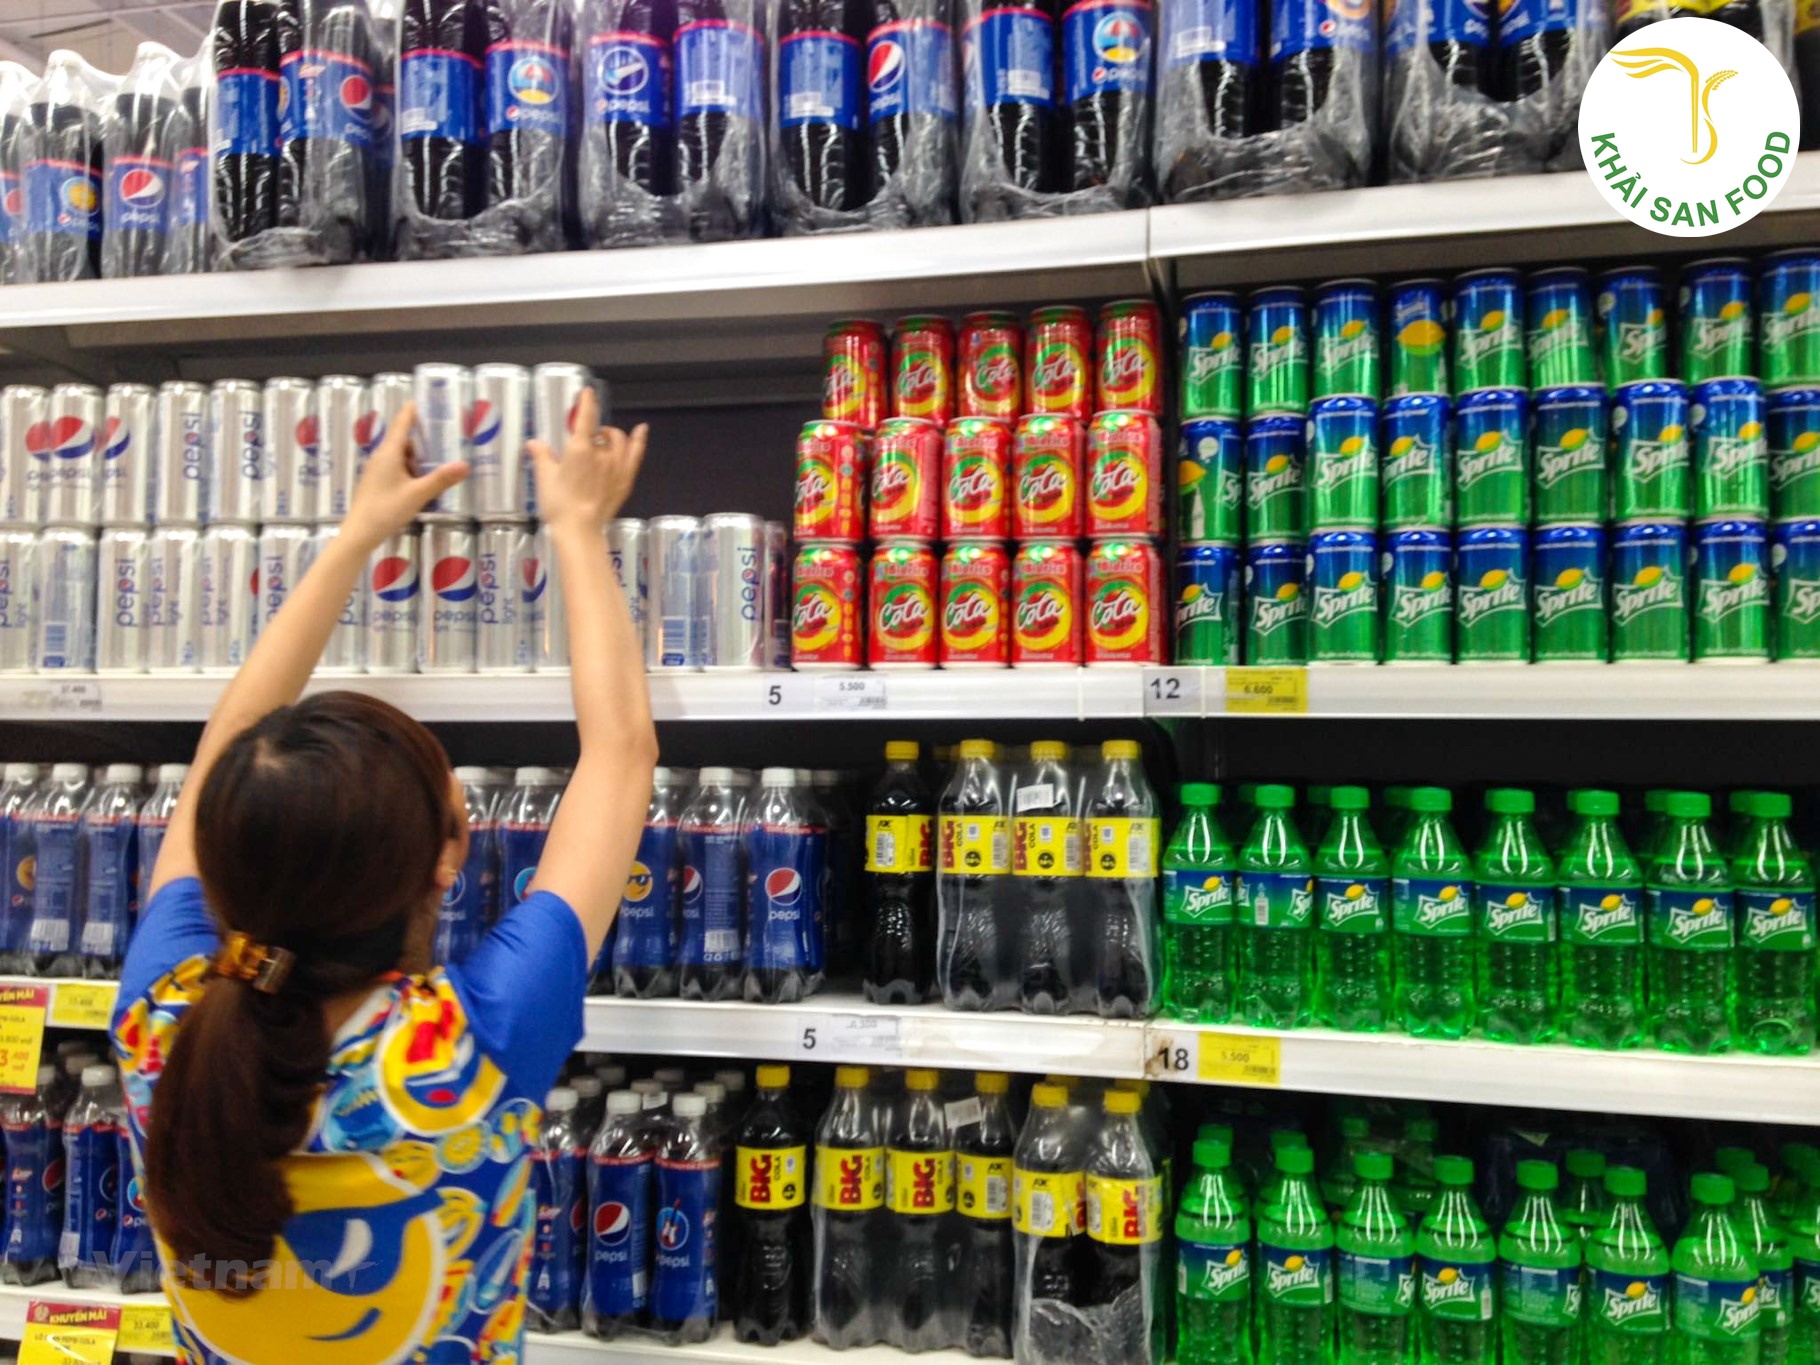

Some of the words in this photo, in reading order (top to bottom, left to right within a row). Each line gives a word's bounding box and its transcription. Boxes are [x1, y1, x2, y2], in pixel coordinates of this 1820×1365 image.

[182, 412, 202, 480] pepsi
[240, 411, 262, 481] pepsi
[1458, 443, 1516, 483] Sprite
[1540, 443, 1598, 480] Sprite
[950, 464, 998, 499] Cola
[1019, 463, 1068, 504] Cola
[1089, 460, 1141, 500] Cola
[1319, 451, 1376, 486] Sprite
[115, 558, 140, 628] pepsi
[151, 558, 168, 626] pepsi
[480, 553, 501, 625] pepsi
[737, 547, 761, 621] pepsi
[1315, 583, 1376, 620] Sprite
[1396, 583, 1453, 622] Sprite
[1459, 582, 1521, 622] Sprite
[1536, 580, 1597, 619] Sprite
[1613, 578, 1678, 617] Sprite
[1702, 578, 1766, 616] Sprite
[879, 592, 929, 632] Cola
[945, 591, 993, 631] Cola
[1017, 590, 1065, 631] Cola
[1090, 590, 1142, 631] Cola
[768, 685, 782, 706] 5
[1150, 678, 1181, 699] 12
[768, 909, 801, 921] pepsi
[1186, 885, 1231, 912] Sprite
[1328, 892, 1376, 920] Sprite
[1420, 893, 1467, 923] Sprite
[1488, 903, 1538, 928] Sprite
[1581, 905, 1633, 931] Sprite
[1672, 910, 1725, 936] Sprite
[1752, 908, 1803, 936] Sprite
[803, 1028, 816, 1049] 5
[1158, 1048, 1190, 1070] 18
[750, 1154, 772, 1203] BIG
[840, 1154, 863, 1205] BIG
[913, 1158, 936, 1208] BIG
[1122, 1185, 1147, 1238] BIG
[594, 1252, 629, 1264] pepsi
[1267, 1263, 1315, 1291] Sprite
[1423, 1279, 1469, 1305] Sprite
[1605, 1289, 1656, 1317] Sprite
